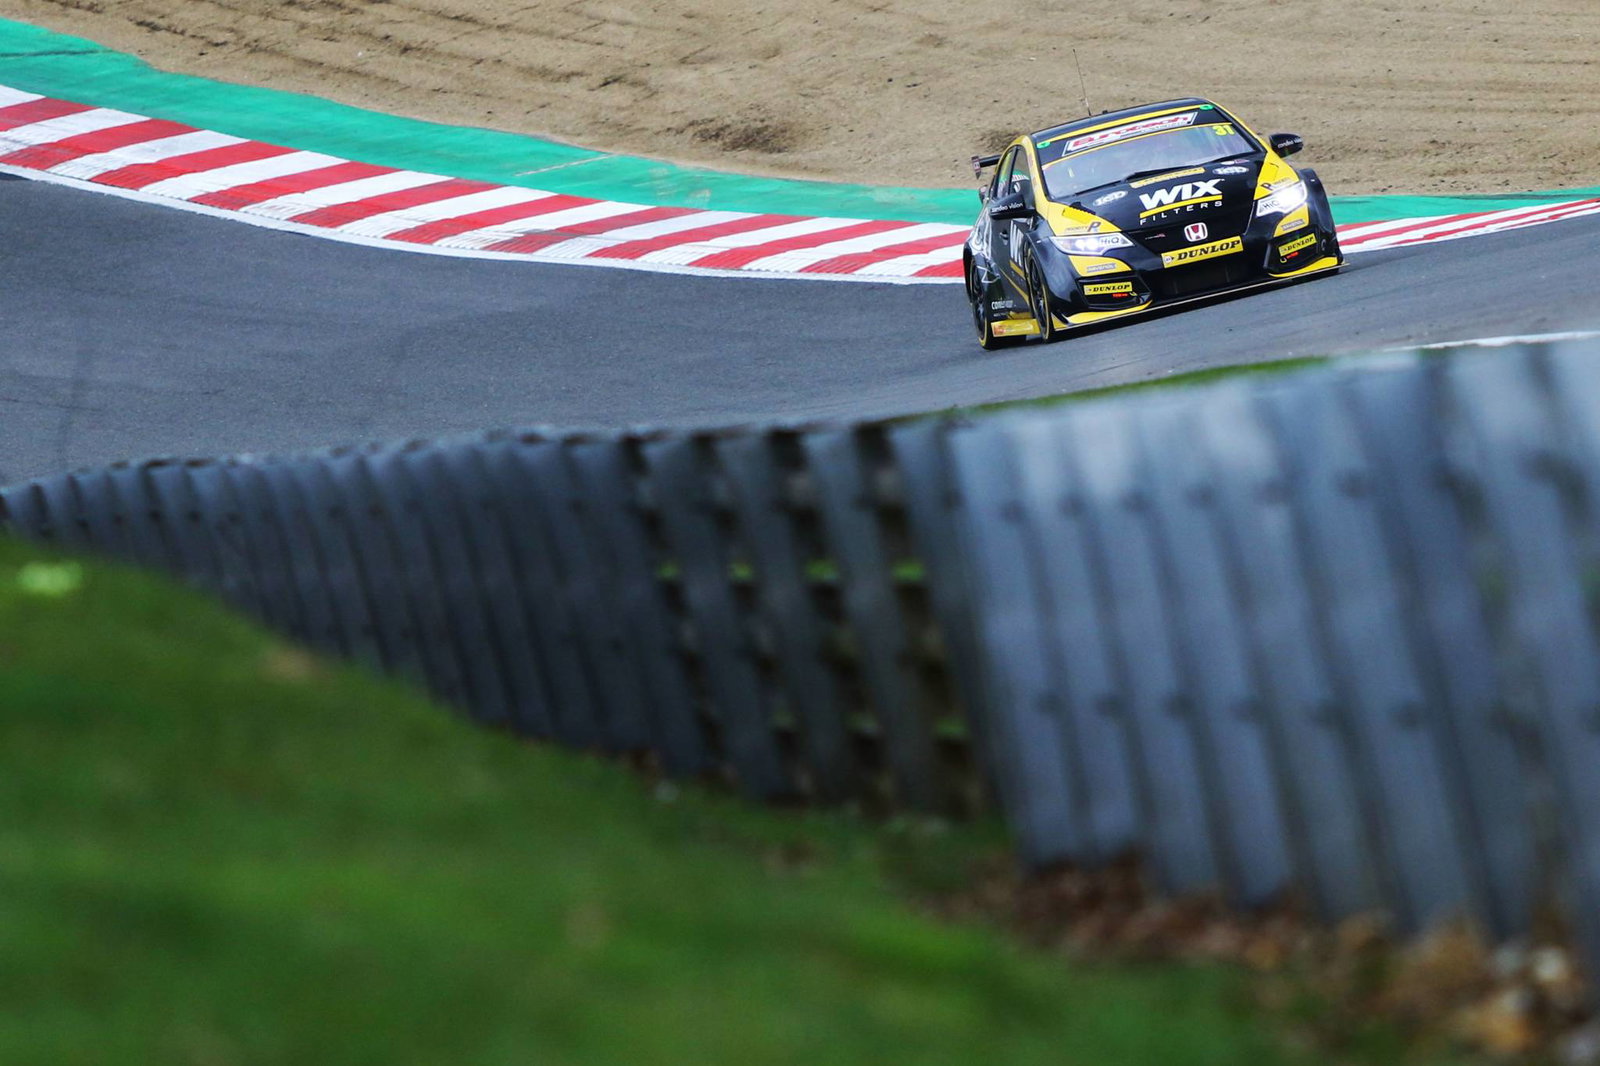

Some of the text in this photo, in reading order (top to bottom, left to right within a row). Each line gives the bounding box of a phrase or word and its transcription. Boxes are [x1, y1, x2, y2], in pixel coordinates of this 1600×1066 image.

[1213, 124, 1235, 137] 31
[1139, 178, 1223, 211] WIX
[1139, 200, 1223, 225] FILTERS
[1177, 239, 1241, 261] DUNLOP
[1287, 236, 1314, 251] DUNLOP
[1092, 284, 1130, 292] DUNLOP
